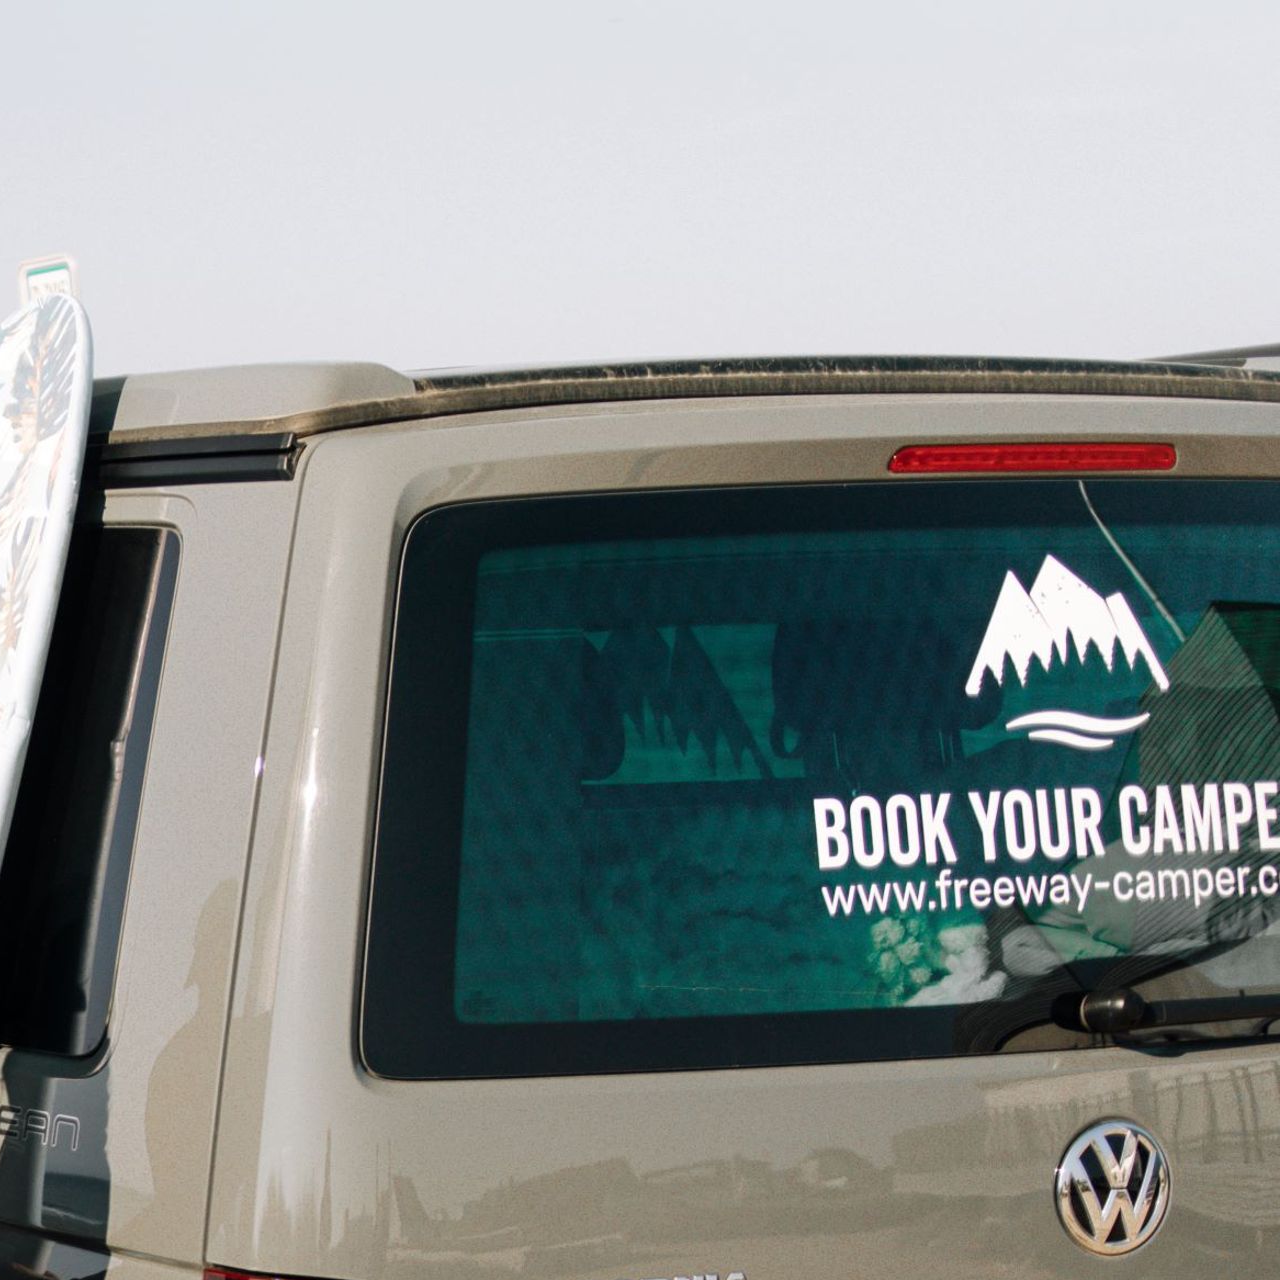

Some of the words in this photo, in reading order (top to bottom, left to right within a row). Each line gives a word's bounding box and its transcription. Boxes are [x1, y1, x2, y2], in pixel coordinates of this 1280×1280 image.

[813, 791, 958, 870] BOOK
[968, 786, 1106, 862] YOUR
[821, 864, 1280, 918] www.freeway-camper.c
